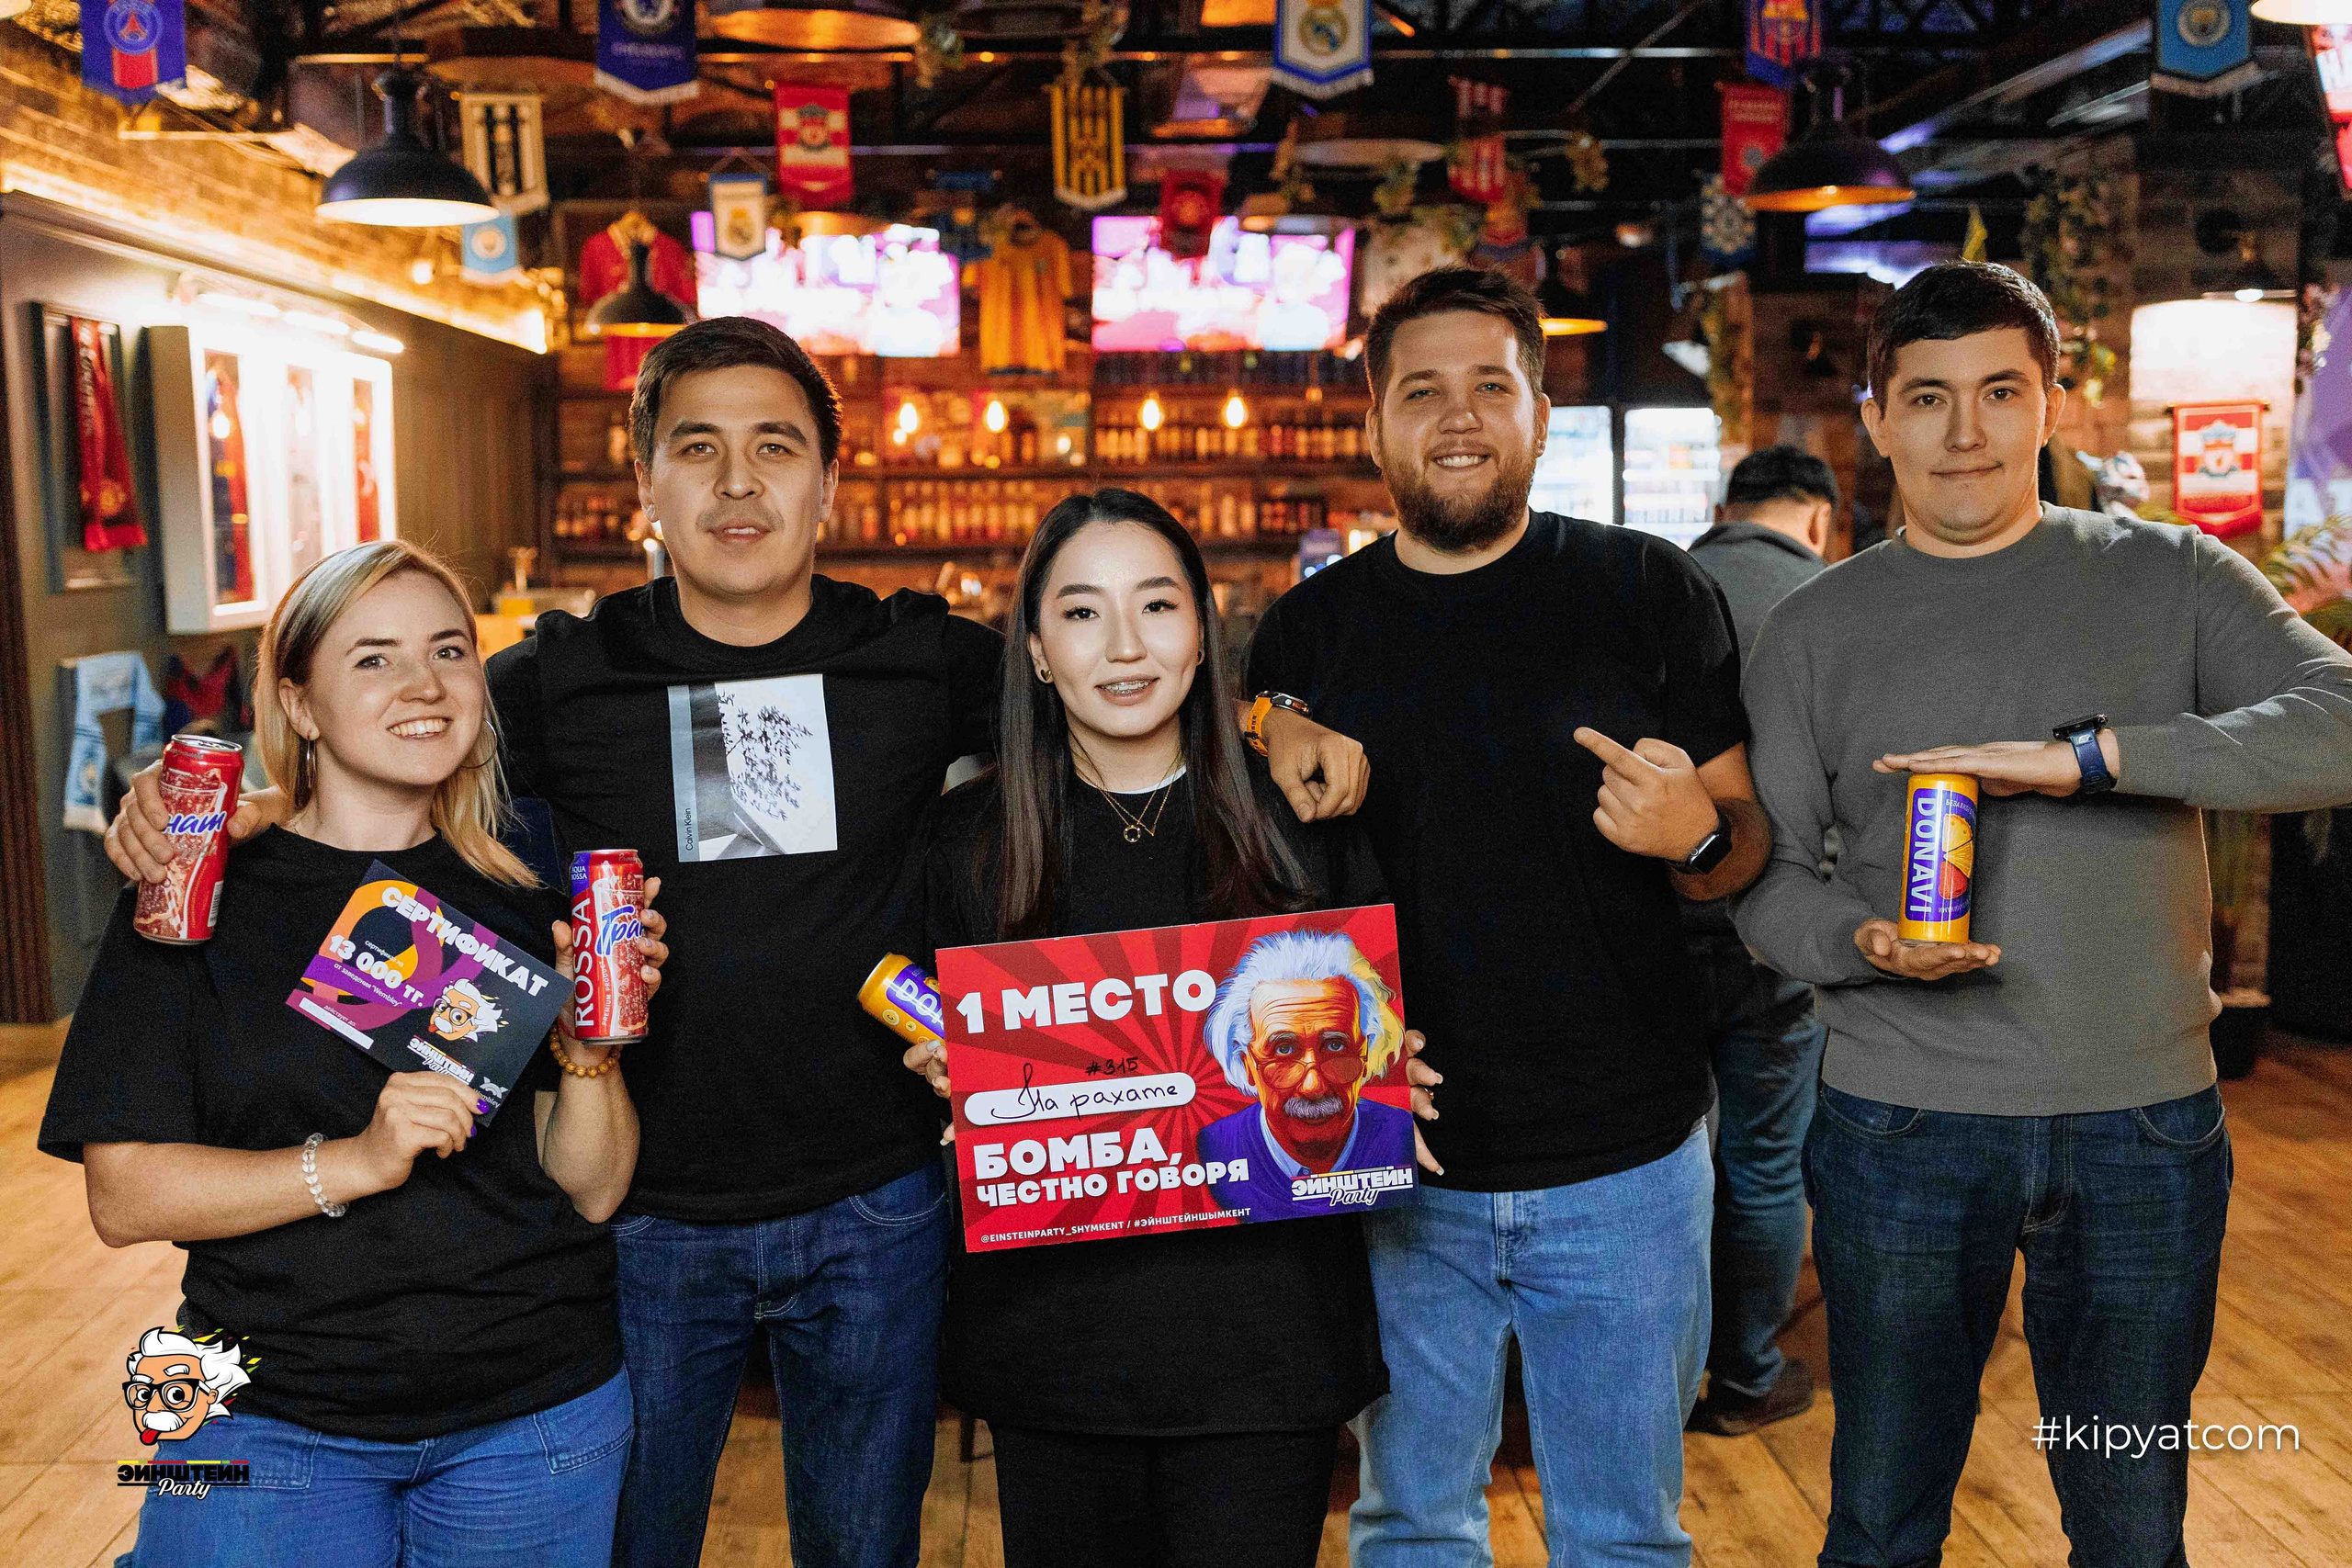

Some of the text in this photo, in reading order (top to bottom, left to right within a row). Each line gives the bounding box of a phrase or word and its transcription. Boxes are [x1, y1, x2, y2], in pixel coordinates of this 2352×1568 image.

[685, 827, 694, 851] Calvin
[1910, 797, 1938, 913] DONAVI
[329, 935, 356, 960] 13
[356, 952, 403, 988] 000
[381, 886, 549, 997] СЕРТИФИКАТ
[571, 897, 594, 1027] ROSSA
[601, 994, 612, 1026] PREMIUM
[956, 970, 1216, 1034] 1 МЕСТО
[1085, 1056, 1139, 1077] #315
[1069, 1085, 1179, 1122] рахате
[973, 1127, 1182, 1180] БОМБА,
[976, 1158, 1250, 1208] ЧЕСТНО ГОВОРЯ
[1291, 1166, 1413, 1196] ЭЙНШТЕЙН
[1329, 1188, 1379, 1206] Party
[980, 1220, 1125, 1243] @EINSTEINPARTY_SHYMKENT
[1134, 1208, 1251, 1227] #ЭЙНШТЕЙНШЫМКЕНТ
